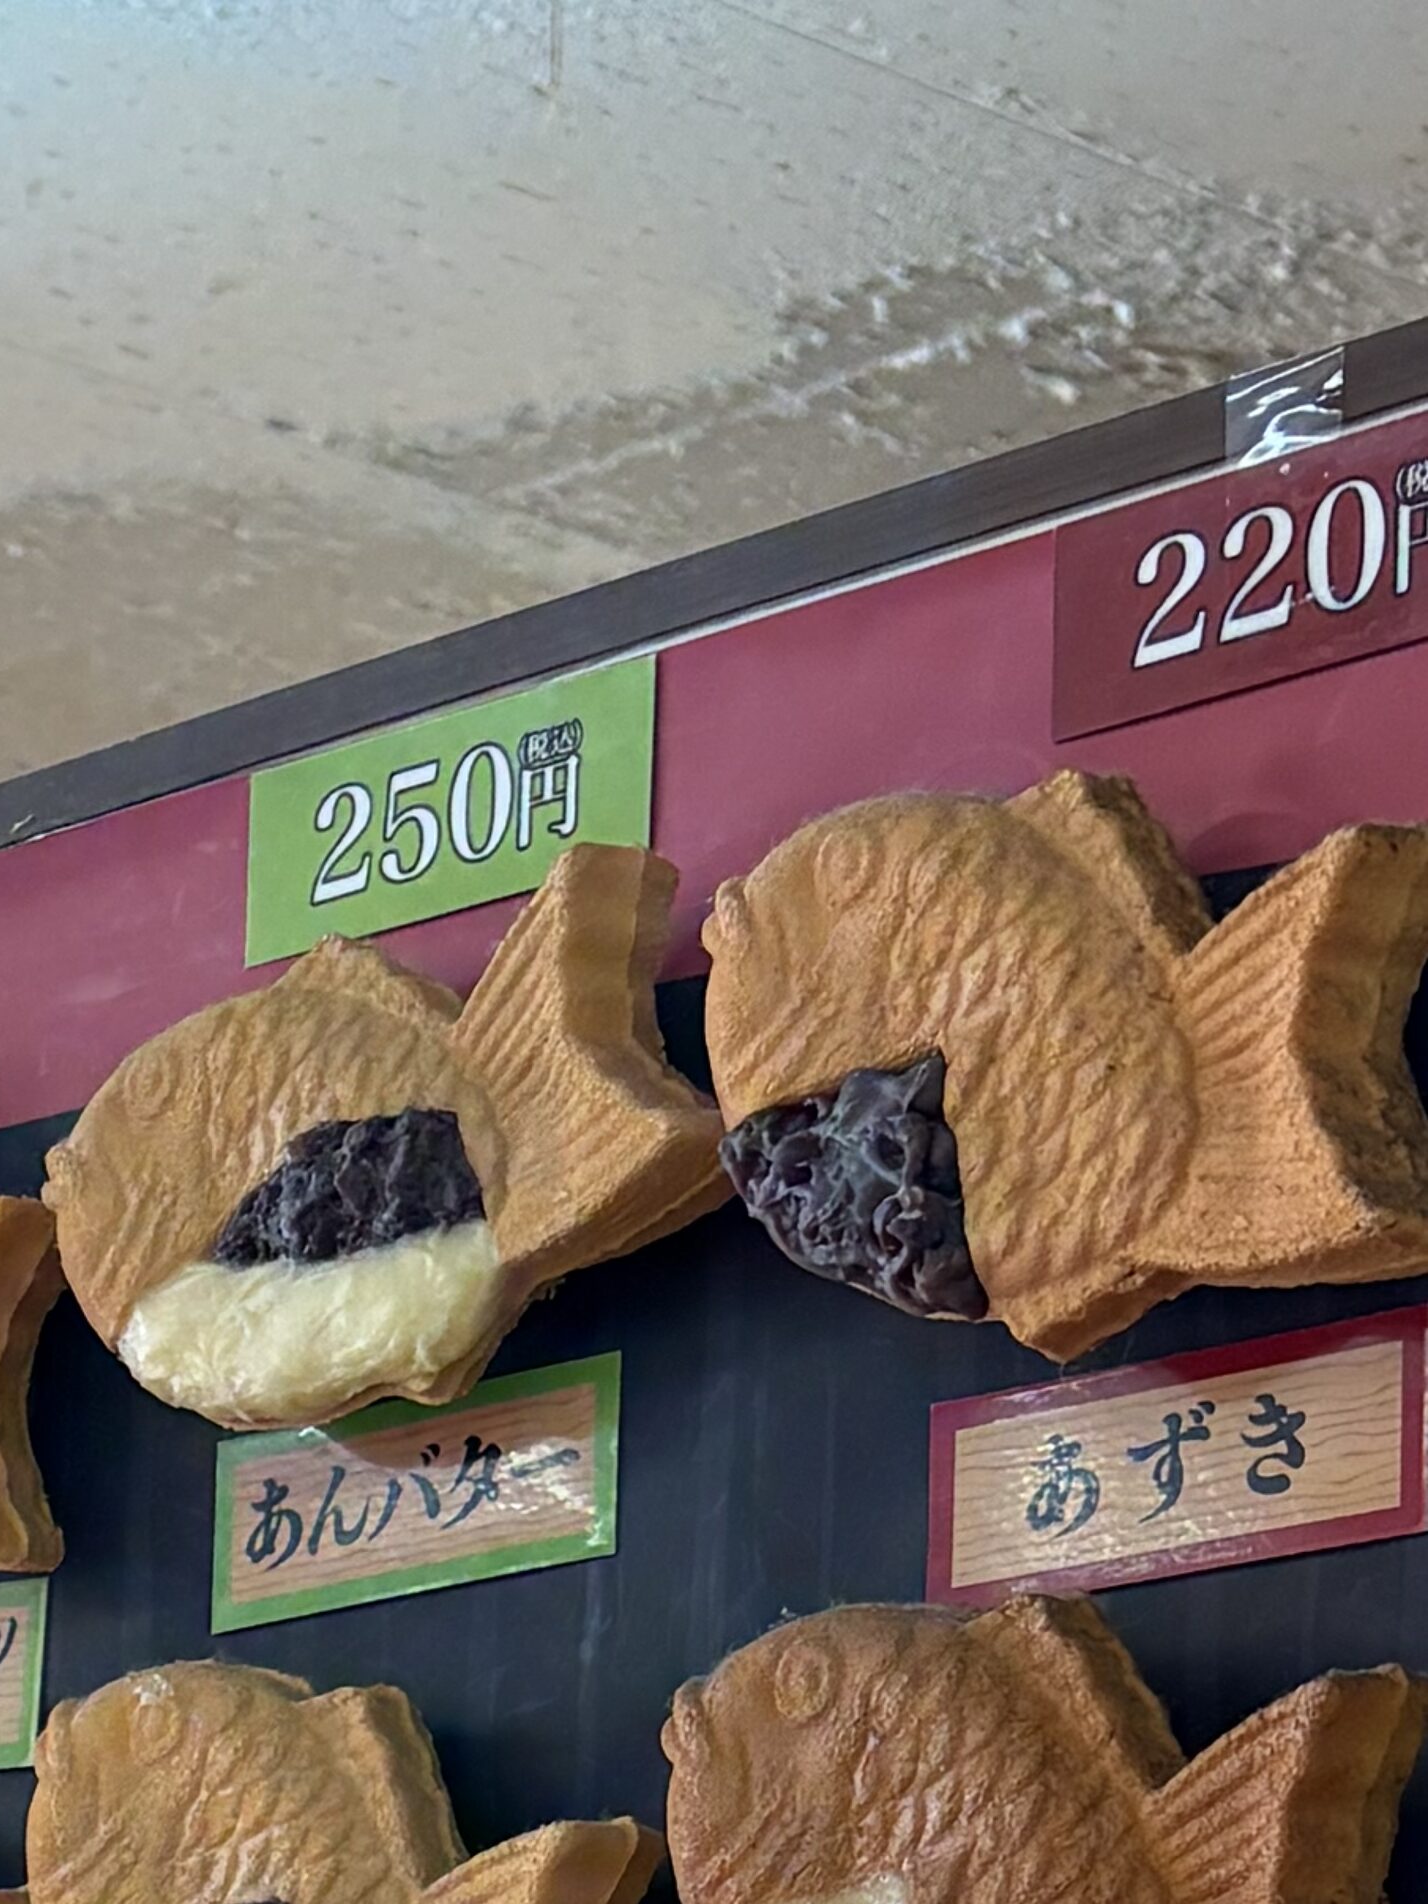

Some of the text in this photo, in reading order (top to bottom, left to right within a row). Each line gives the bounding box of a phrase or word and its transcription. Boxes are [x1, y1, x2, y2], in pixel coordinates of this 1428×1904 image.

[244, 1432, 582, 1571] あんバター
[1027, 1393, 1308, 1537] あずき
